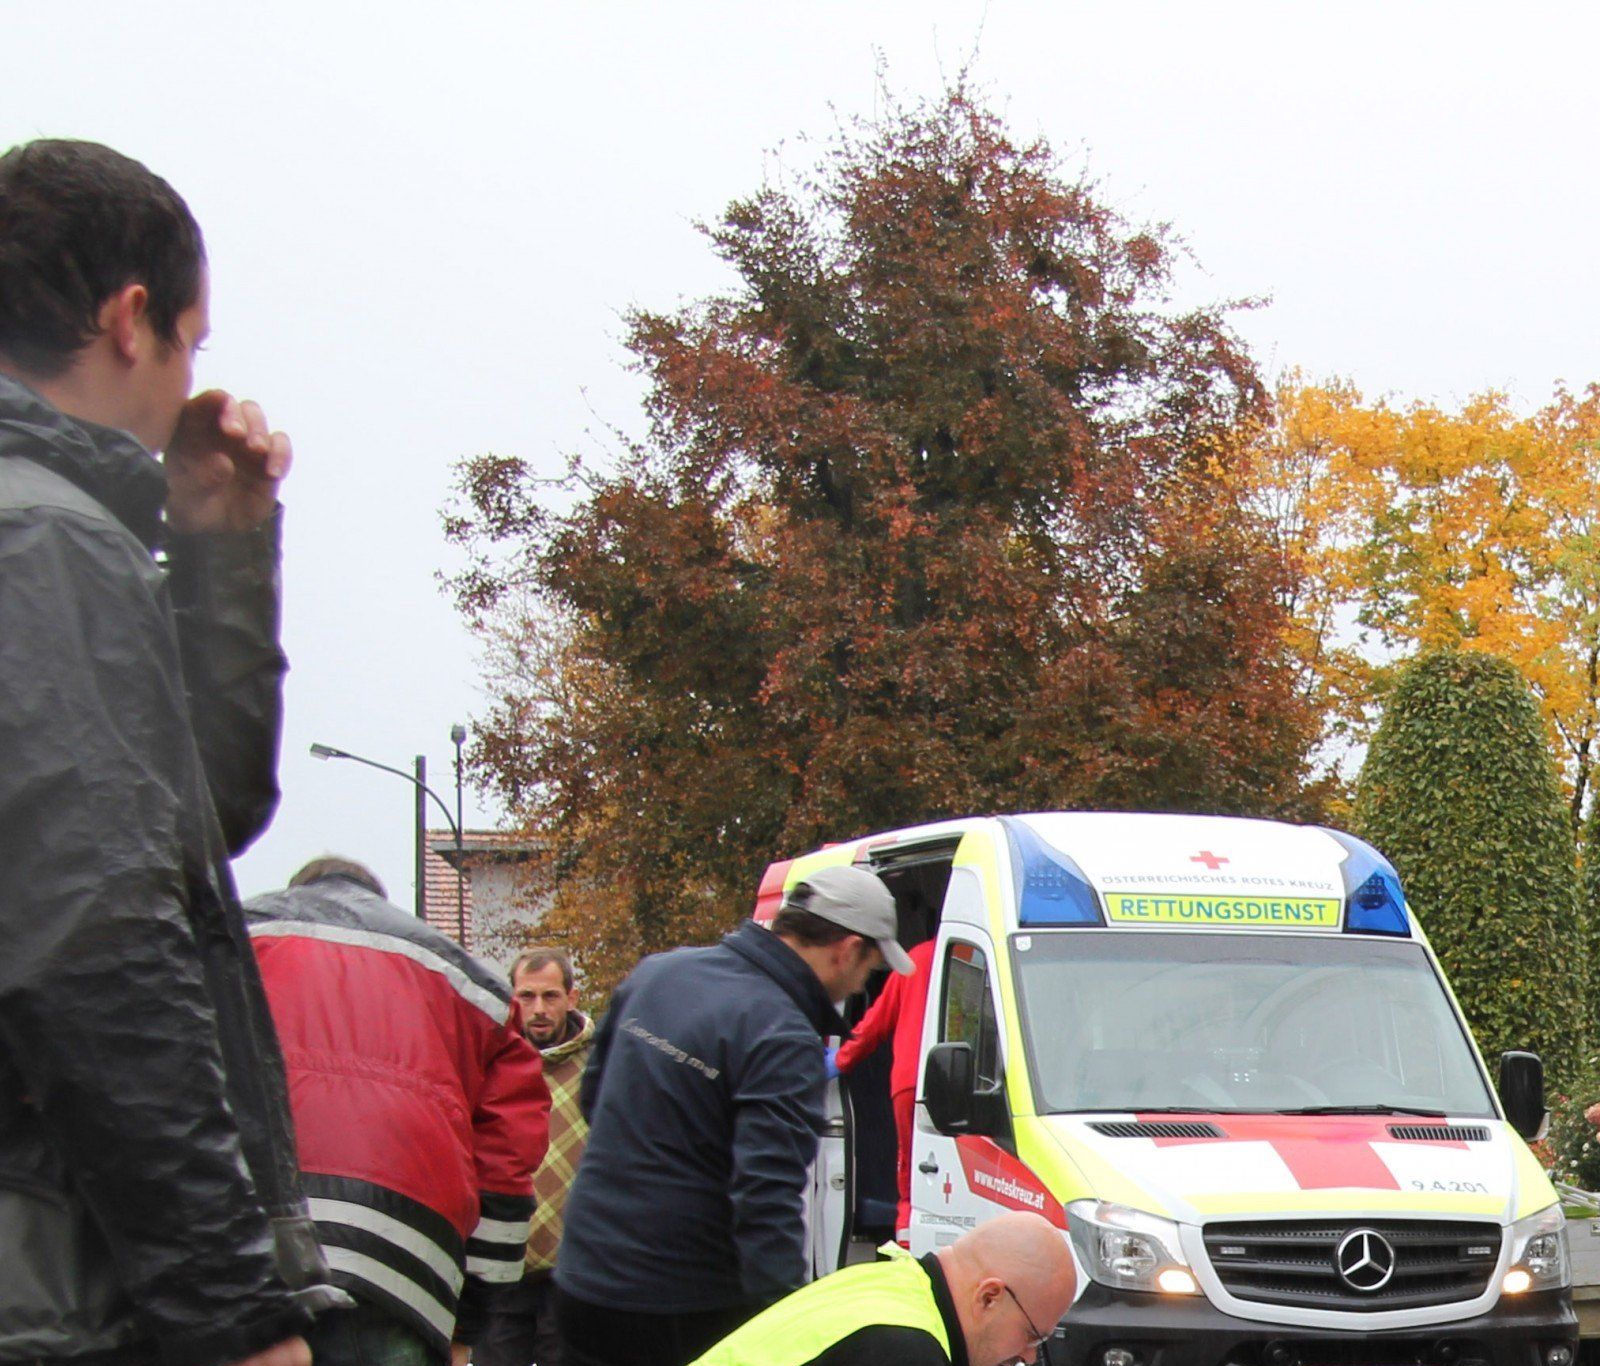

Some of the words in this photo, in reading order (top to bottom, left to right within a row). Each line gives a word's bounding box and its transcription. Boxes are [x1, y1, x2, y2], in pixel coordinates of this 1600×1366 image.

[1102, 873, 1236, 885] ÖSTERREICHISCHES
[1242, 877, 1284, 887] ROTES
[1289, 880, 1334, 891] KREUZ
[1120, 898, 1326, 921] RETTUNGSDIENST
[974, 1169, 1045, 1210] www.roteskreuz.at
